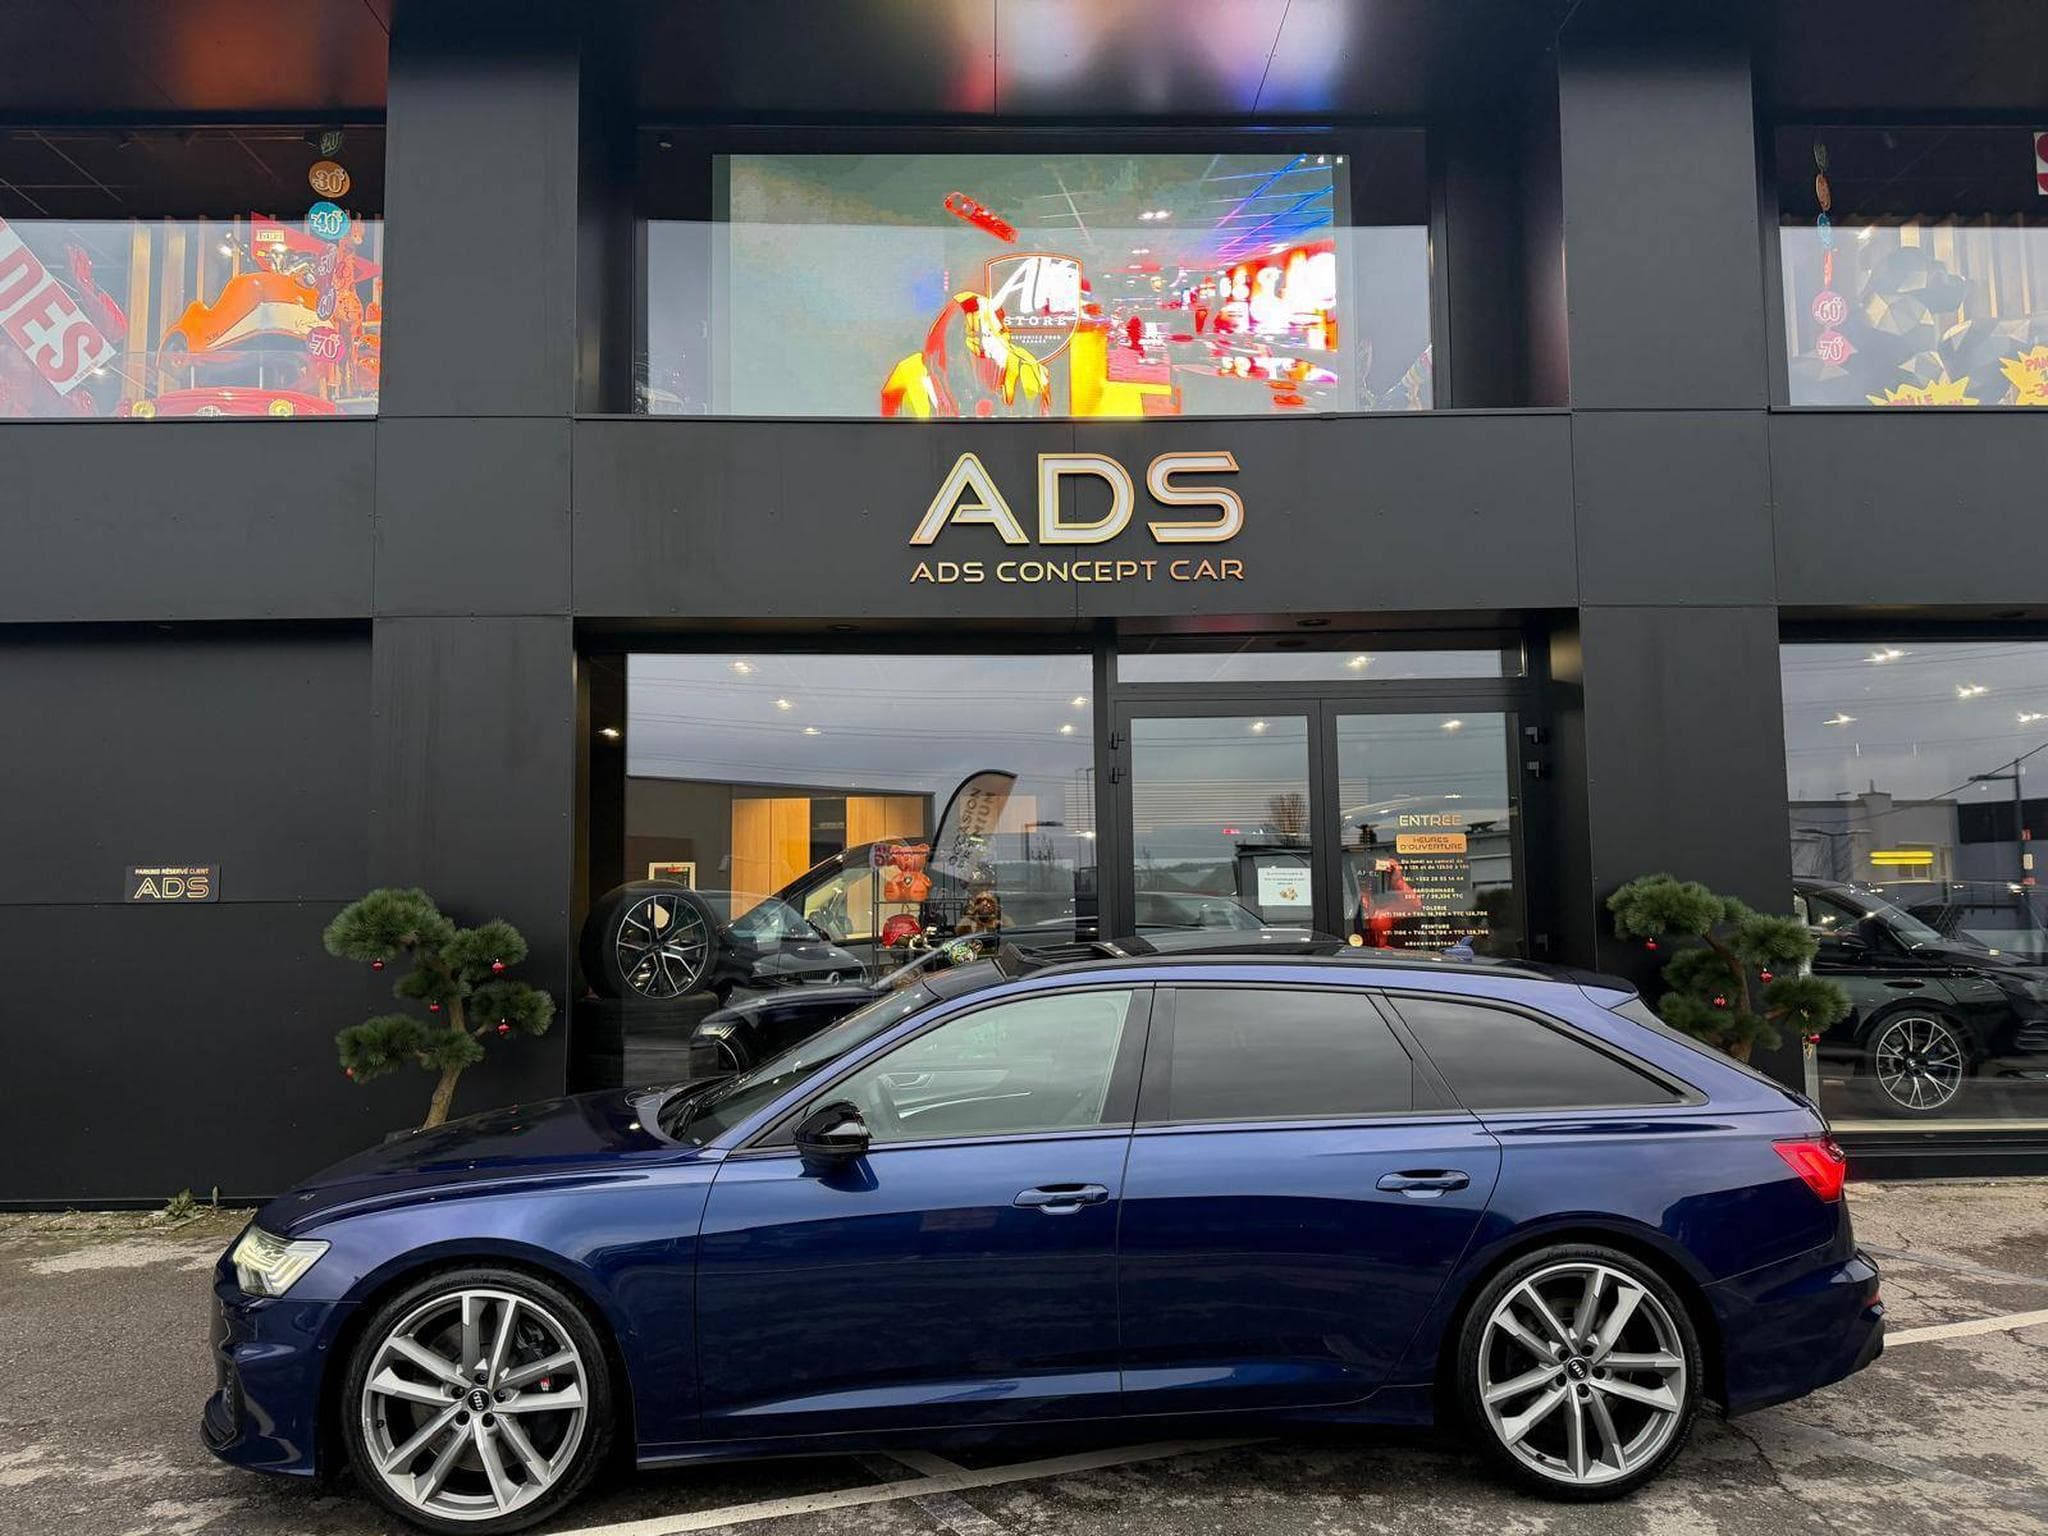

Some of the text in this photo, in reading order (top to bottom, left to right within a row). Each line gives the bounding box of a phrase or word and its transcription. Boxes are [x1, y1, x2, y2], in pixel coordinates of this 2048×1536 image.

[0, 219, 104, 384] DES
[1003, 316, 1067, 326] STORE
[908, 451, 1246, 546] ADS
[910, 559, 1245, 584] ADS CONCEPT CAR
[1400, 843, 1463, 851] D'OUVERTURE
[190, 867, 210, 875] CLIENT
[134, 876, 210, 899] ADS
